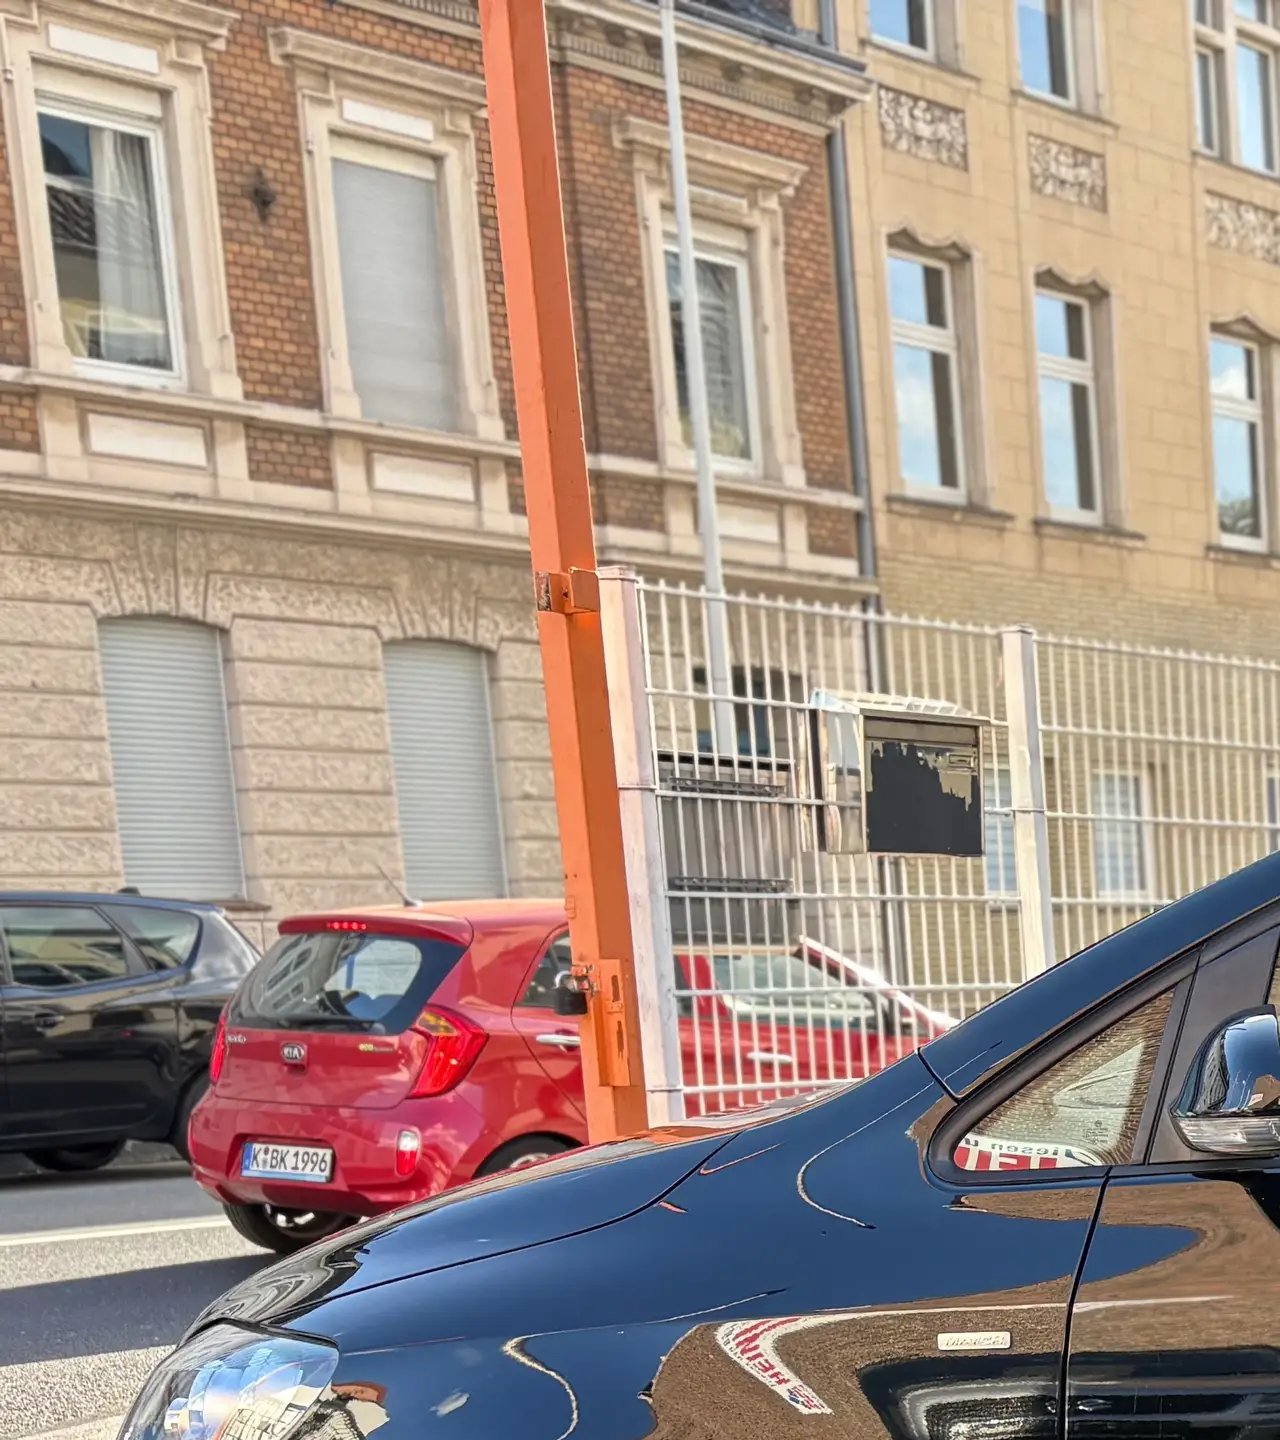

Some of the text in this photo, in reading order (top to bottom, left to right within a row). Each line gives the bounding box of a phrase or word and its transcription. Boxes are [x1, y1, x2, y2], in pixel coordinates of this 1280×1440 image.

[283, 1046, 305, 1060] KIA
[251, 1147, 328, 1173] K BK 1996
